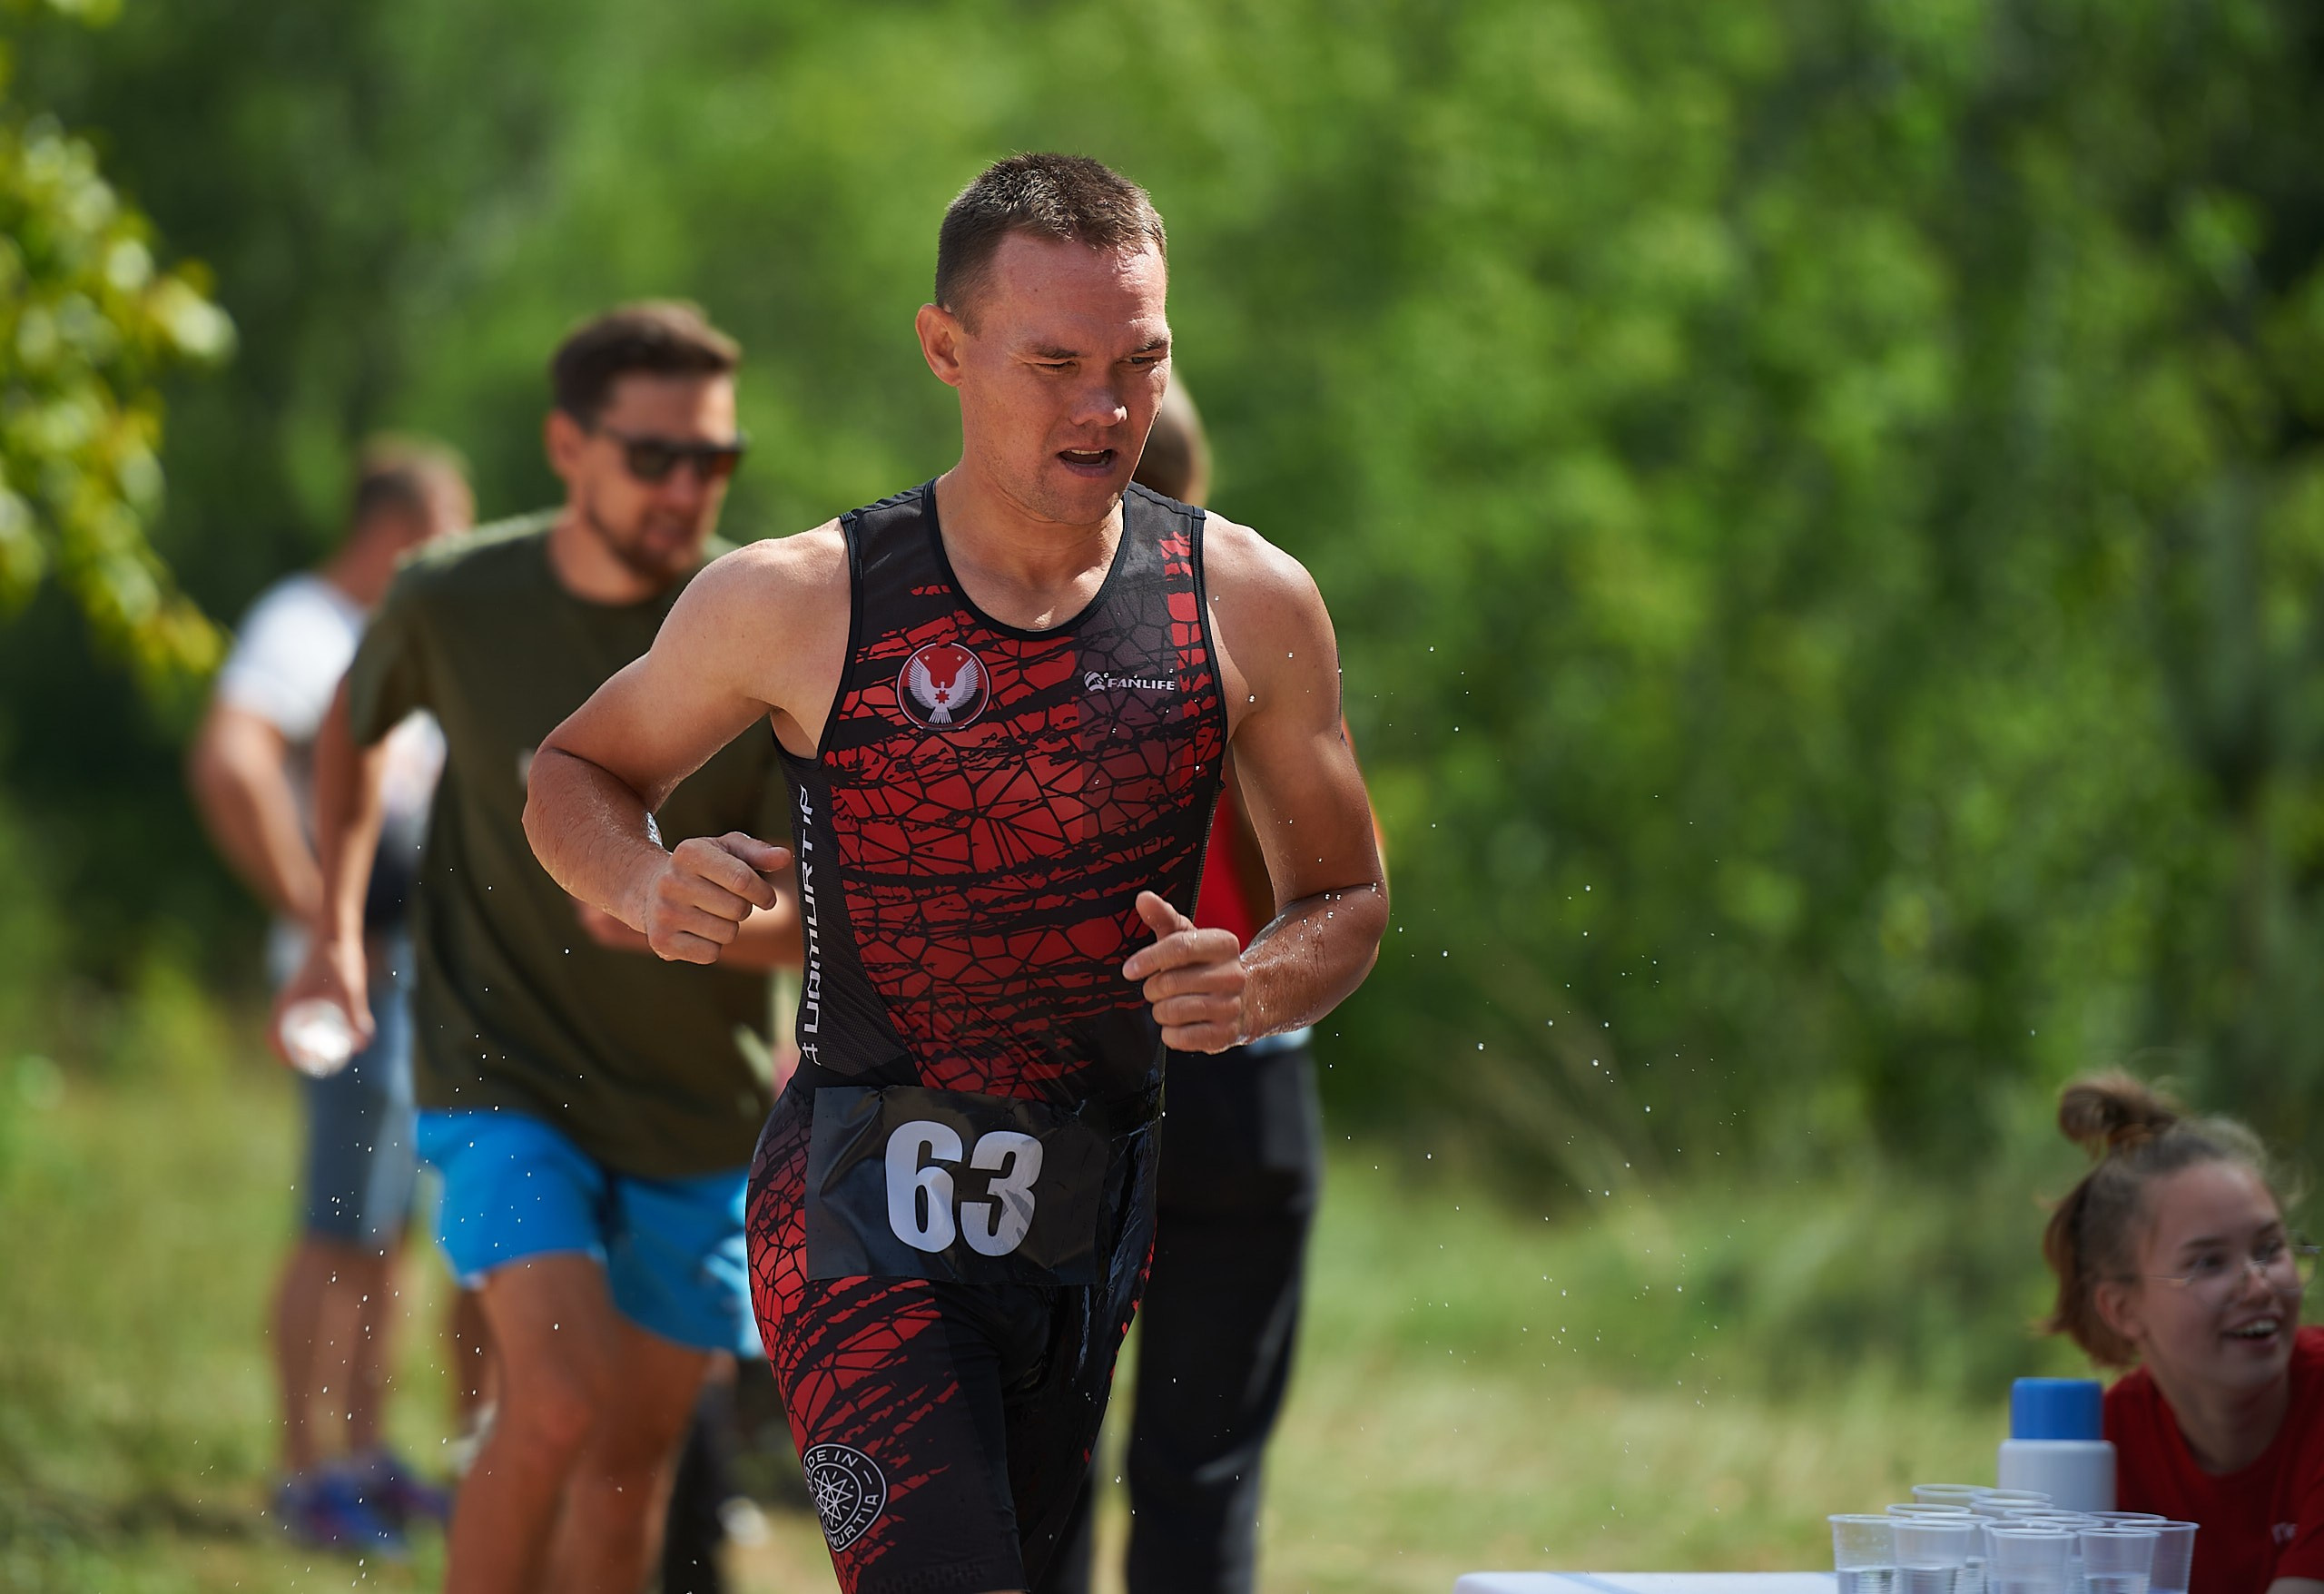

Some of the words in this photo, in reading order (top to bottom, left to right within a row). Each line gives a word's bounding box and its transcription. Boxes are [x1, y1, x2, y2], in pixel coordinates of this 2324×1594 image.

[1108, 678, 1176, 690] FANLIFE
[885, 1120, 1043, 1256] 63
[833, 1451, 859, 1467] IN
